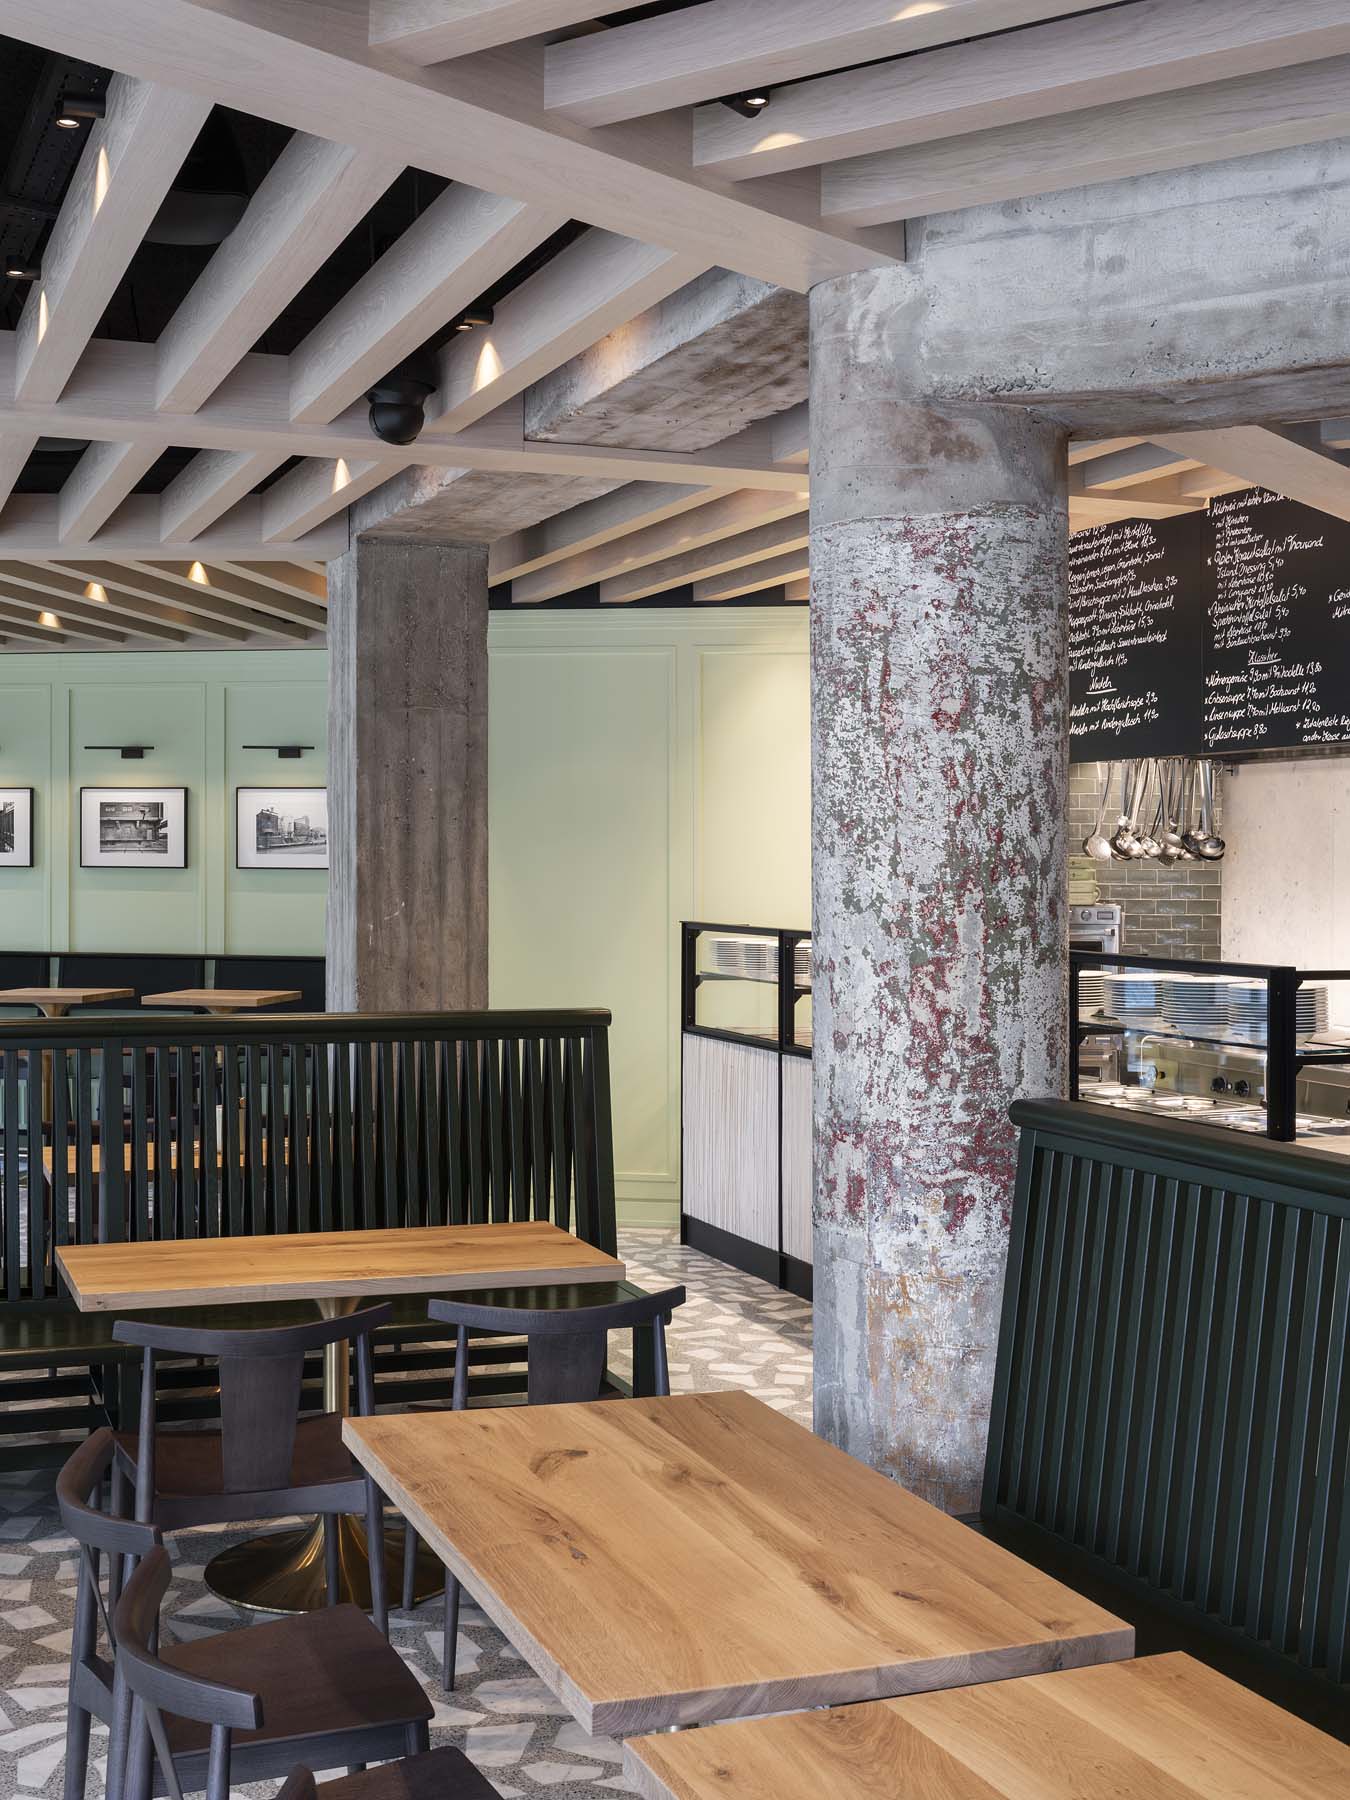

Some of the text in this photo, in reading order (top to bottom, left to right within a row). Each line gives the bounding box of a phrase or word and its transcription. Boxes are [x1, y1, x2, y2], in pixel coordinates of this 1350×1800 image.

[1268, 556, 1284, 570] 5,40
[1291, 584, 1307, 599] 5,40
[1248, 646, 1279, 663] Klassiker
[1208, 691, 1246, 704] Erbsensuppe
[1089, 701, 1100, 713] mit
[1208, 706, 1246, 721] Linsensuppe
[1089, 720, 1099, 731] mit
